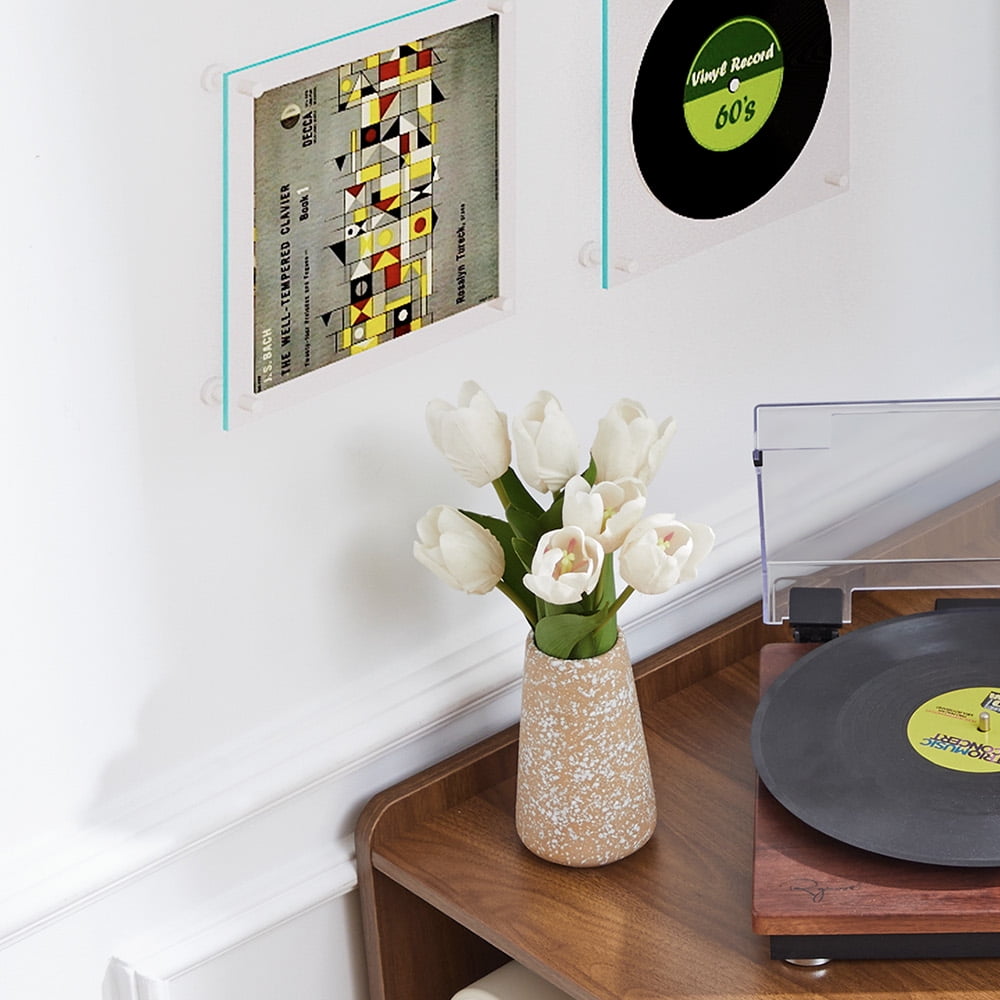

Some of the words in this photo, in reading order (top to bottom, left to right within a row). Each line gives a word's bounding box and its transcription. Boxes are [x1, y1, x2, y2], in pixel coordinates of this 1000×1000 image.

[691, 60, 728, 87] Vinyl
[730, 42, 775, 72] Record
[302, 110, 313, 148] DECCA
[715, 95, 756, 130] 60's
[280, 183, 291, 236] CLAVIER
[299, 194, 310, 222] Book
[280, 241, 291, 348] WELL-TEMPERED
[456, 264, 467, 305] Rosalyn
[280, 350, 292, 378] THE
